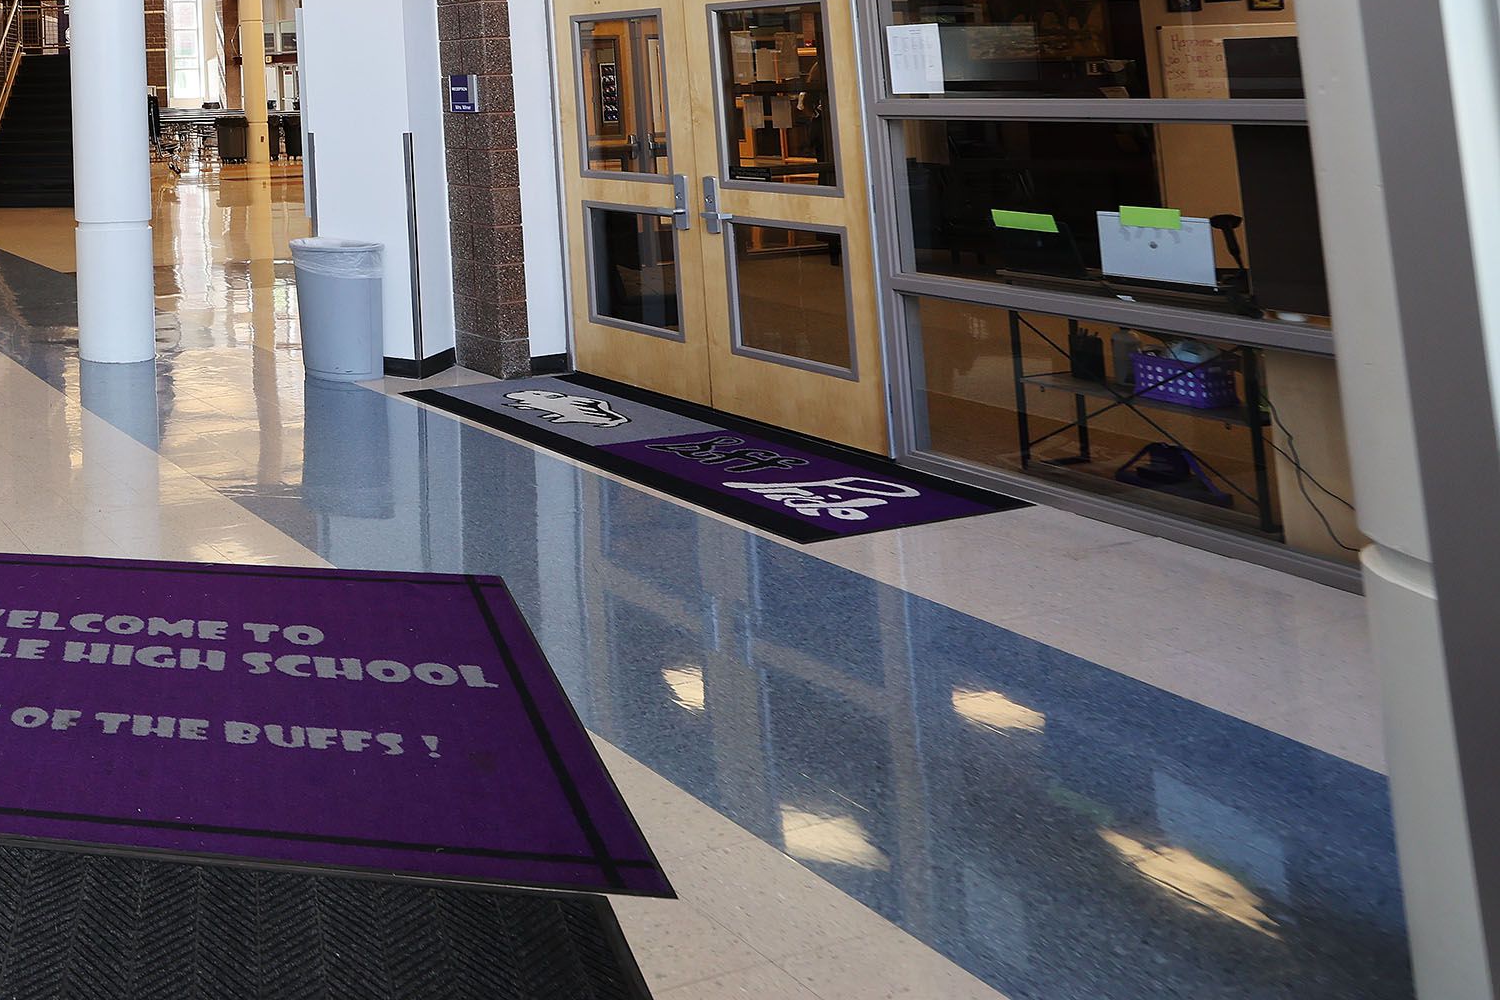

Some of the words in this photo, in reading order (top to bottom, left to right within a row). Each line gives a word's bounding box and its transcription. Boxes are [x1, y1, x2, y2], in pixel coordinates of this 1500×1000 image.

[722, 476, 921, 521] Pride
[243, 622, 325, 646] TO
[62, 640, 226, 671] HIGH
[242, 652, 499, 688] SCHOOL
[10, 706, 82, 730] OF
[94, 711, 210, 741] THE
[223, 720, 404, 756] BUFFS
